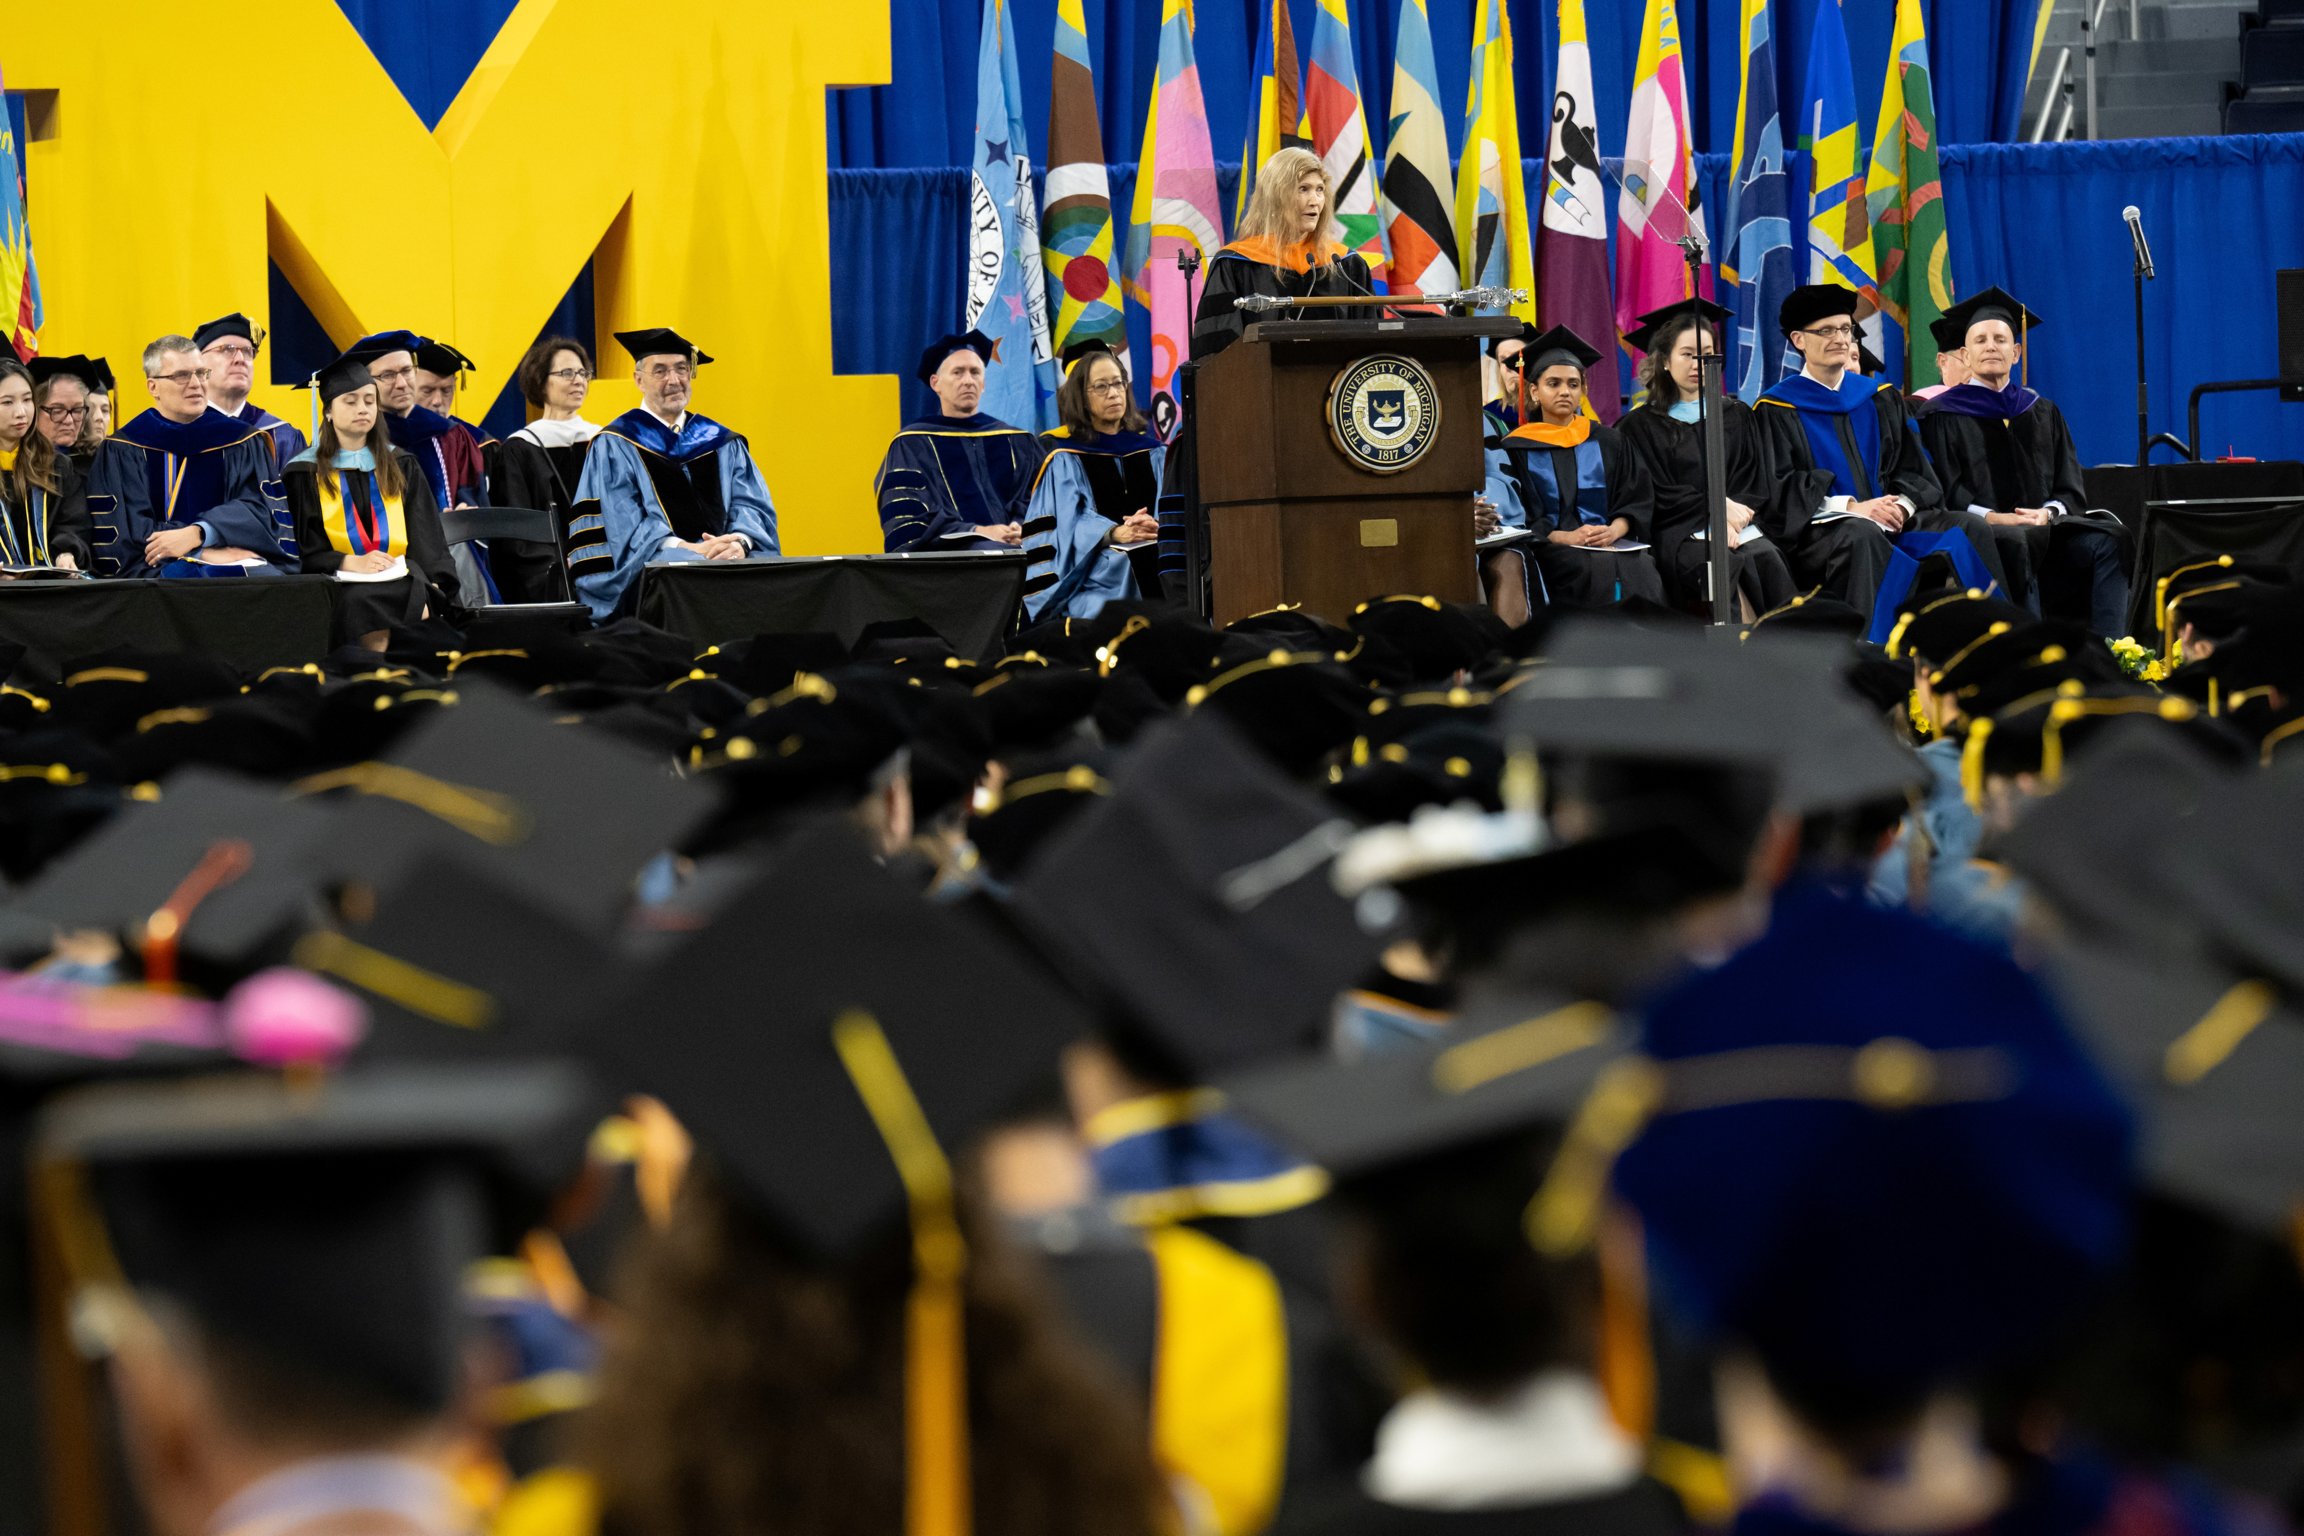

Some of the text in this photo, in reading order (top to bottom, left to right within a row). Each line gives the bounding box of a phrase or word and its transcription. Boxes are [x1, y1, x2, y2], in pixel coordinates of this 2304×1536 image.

[0, 0, 902, 560] M
[980, 250, 1000, 287] OF
[1343, 363, 1431, 445] THE UNIVERSITY OF MICHIGAN
[1377, 449, 1399, 461] 1817
